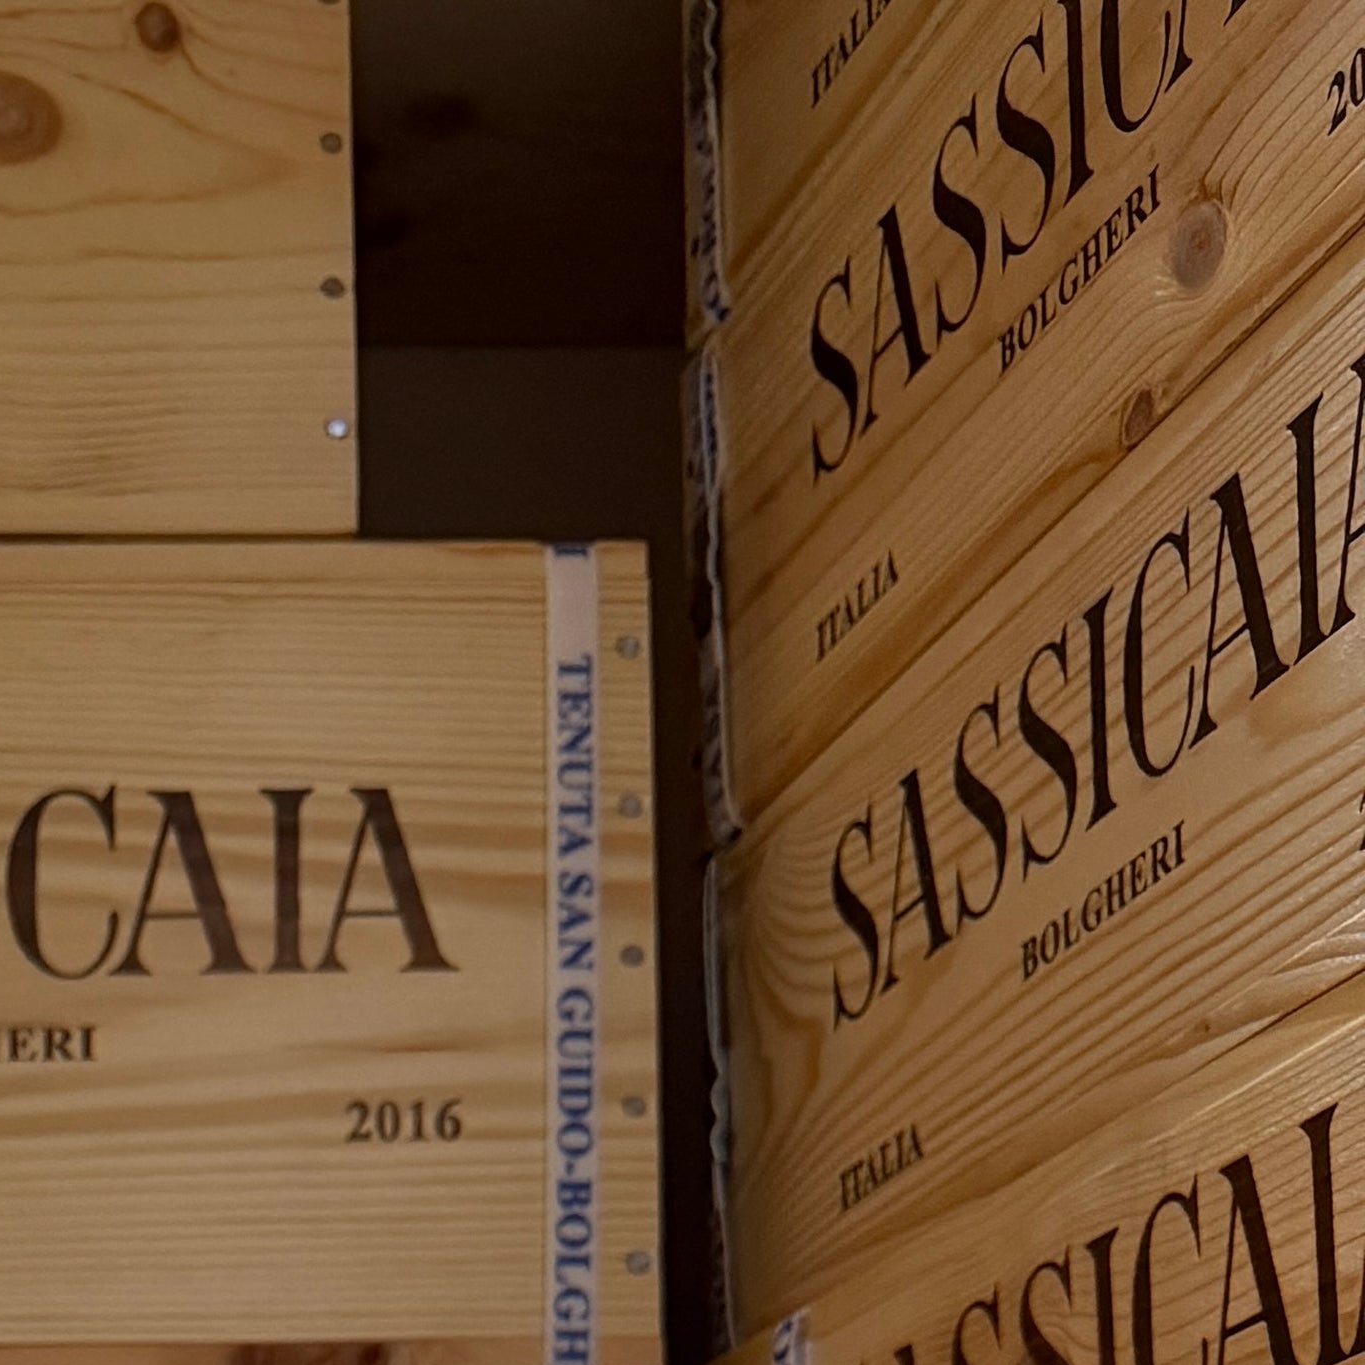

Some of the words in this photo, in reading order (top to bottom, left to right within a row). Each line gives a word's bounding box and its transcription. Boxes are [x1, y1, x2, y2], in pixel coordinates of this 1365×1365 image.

[999, 162, 1161, 377] BOLGHERI
[815, 550, 900, 662] ITALIA
[556, 655, 592, 857] TENUTA
[556, 867, 593, 970] SAN
[1021, 820, 1186, 982] BOLGHERI
[345, 1098, 463, 1143] 2016
[837, 1123, 925, 1212] ITALIA
